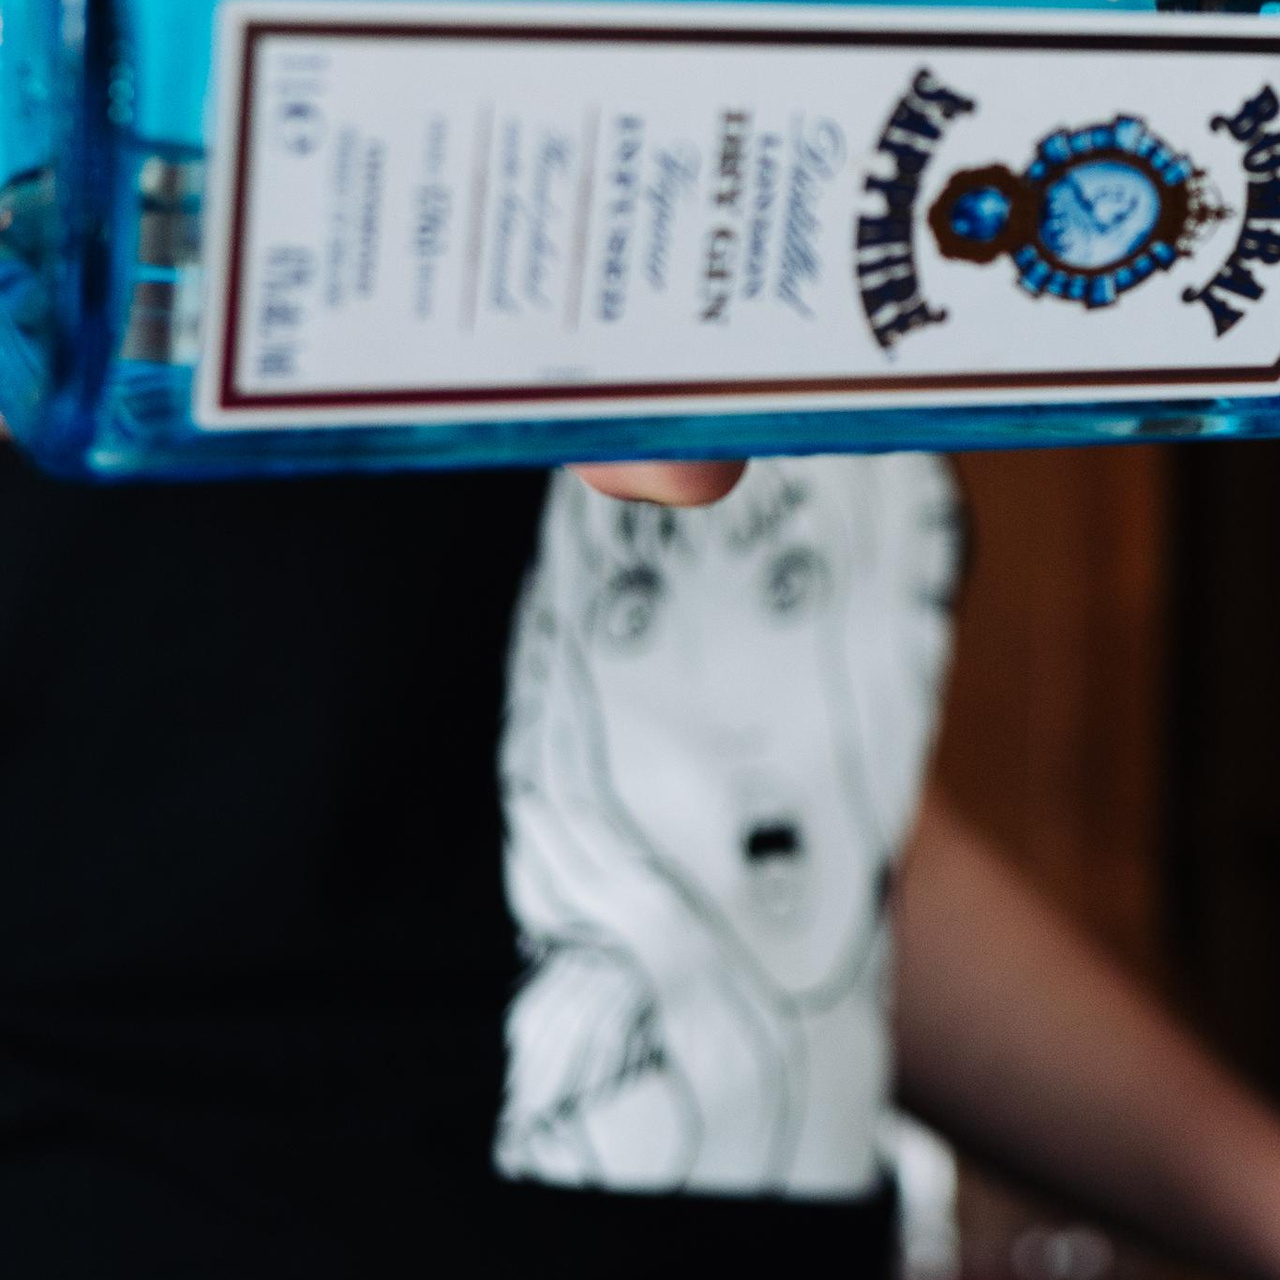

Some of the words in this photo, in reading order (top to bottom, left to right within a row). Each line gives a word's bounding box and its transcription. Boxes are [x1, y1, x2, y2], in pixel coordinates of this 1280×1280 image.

[601, 115, 646, 322] INFUSED
[713, 107, 752, 211] DRY
[743, 133, 782, 301] LONDON
[777, 109, 848, 321] Distilled
[856, 67, 976, 348] SAPPHIRE
[700, 227, 740, 323] GIN
